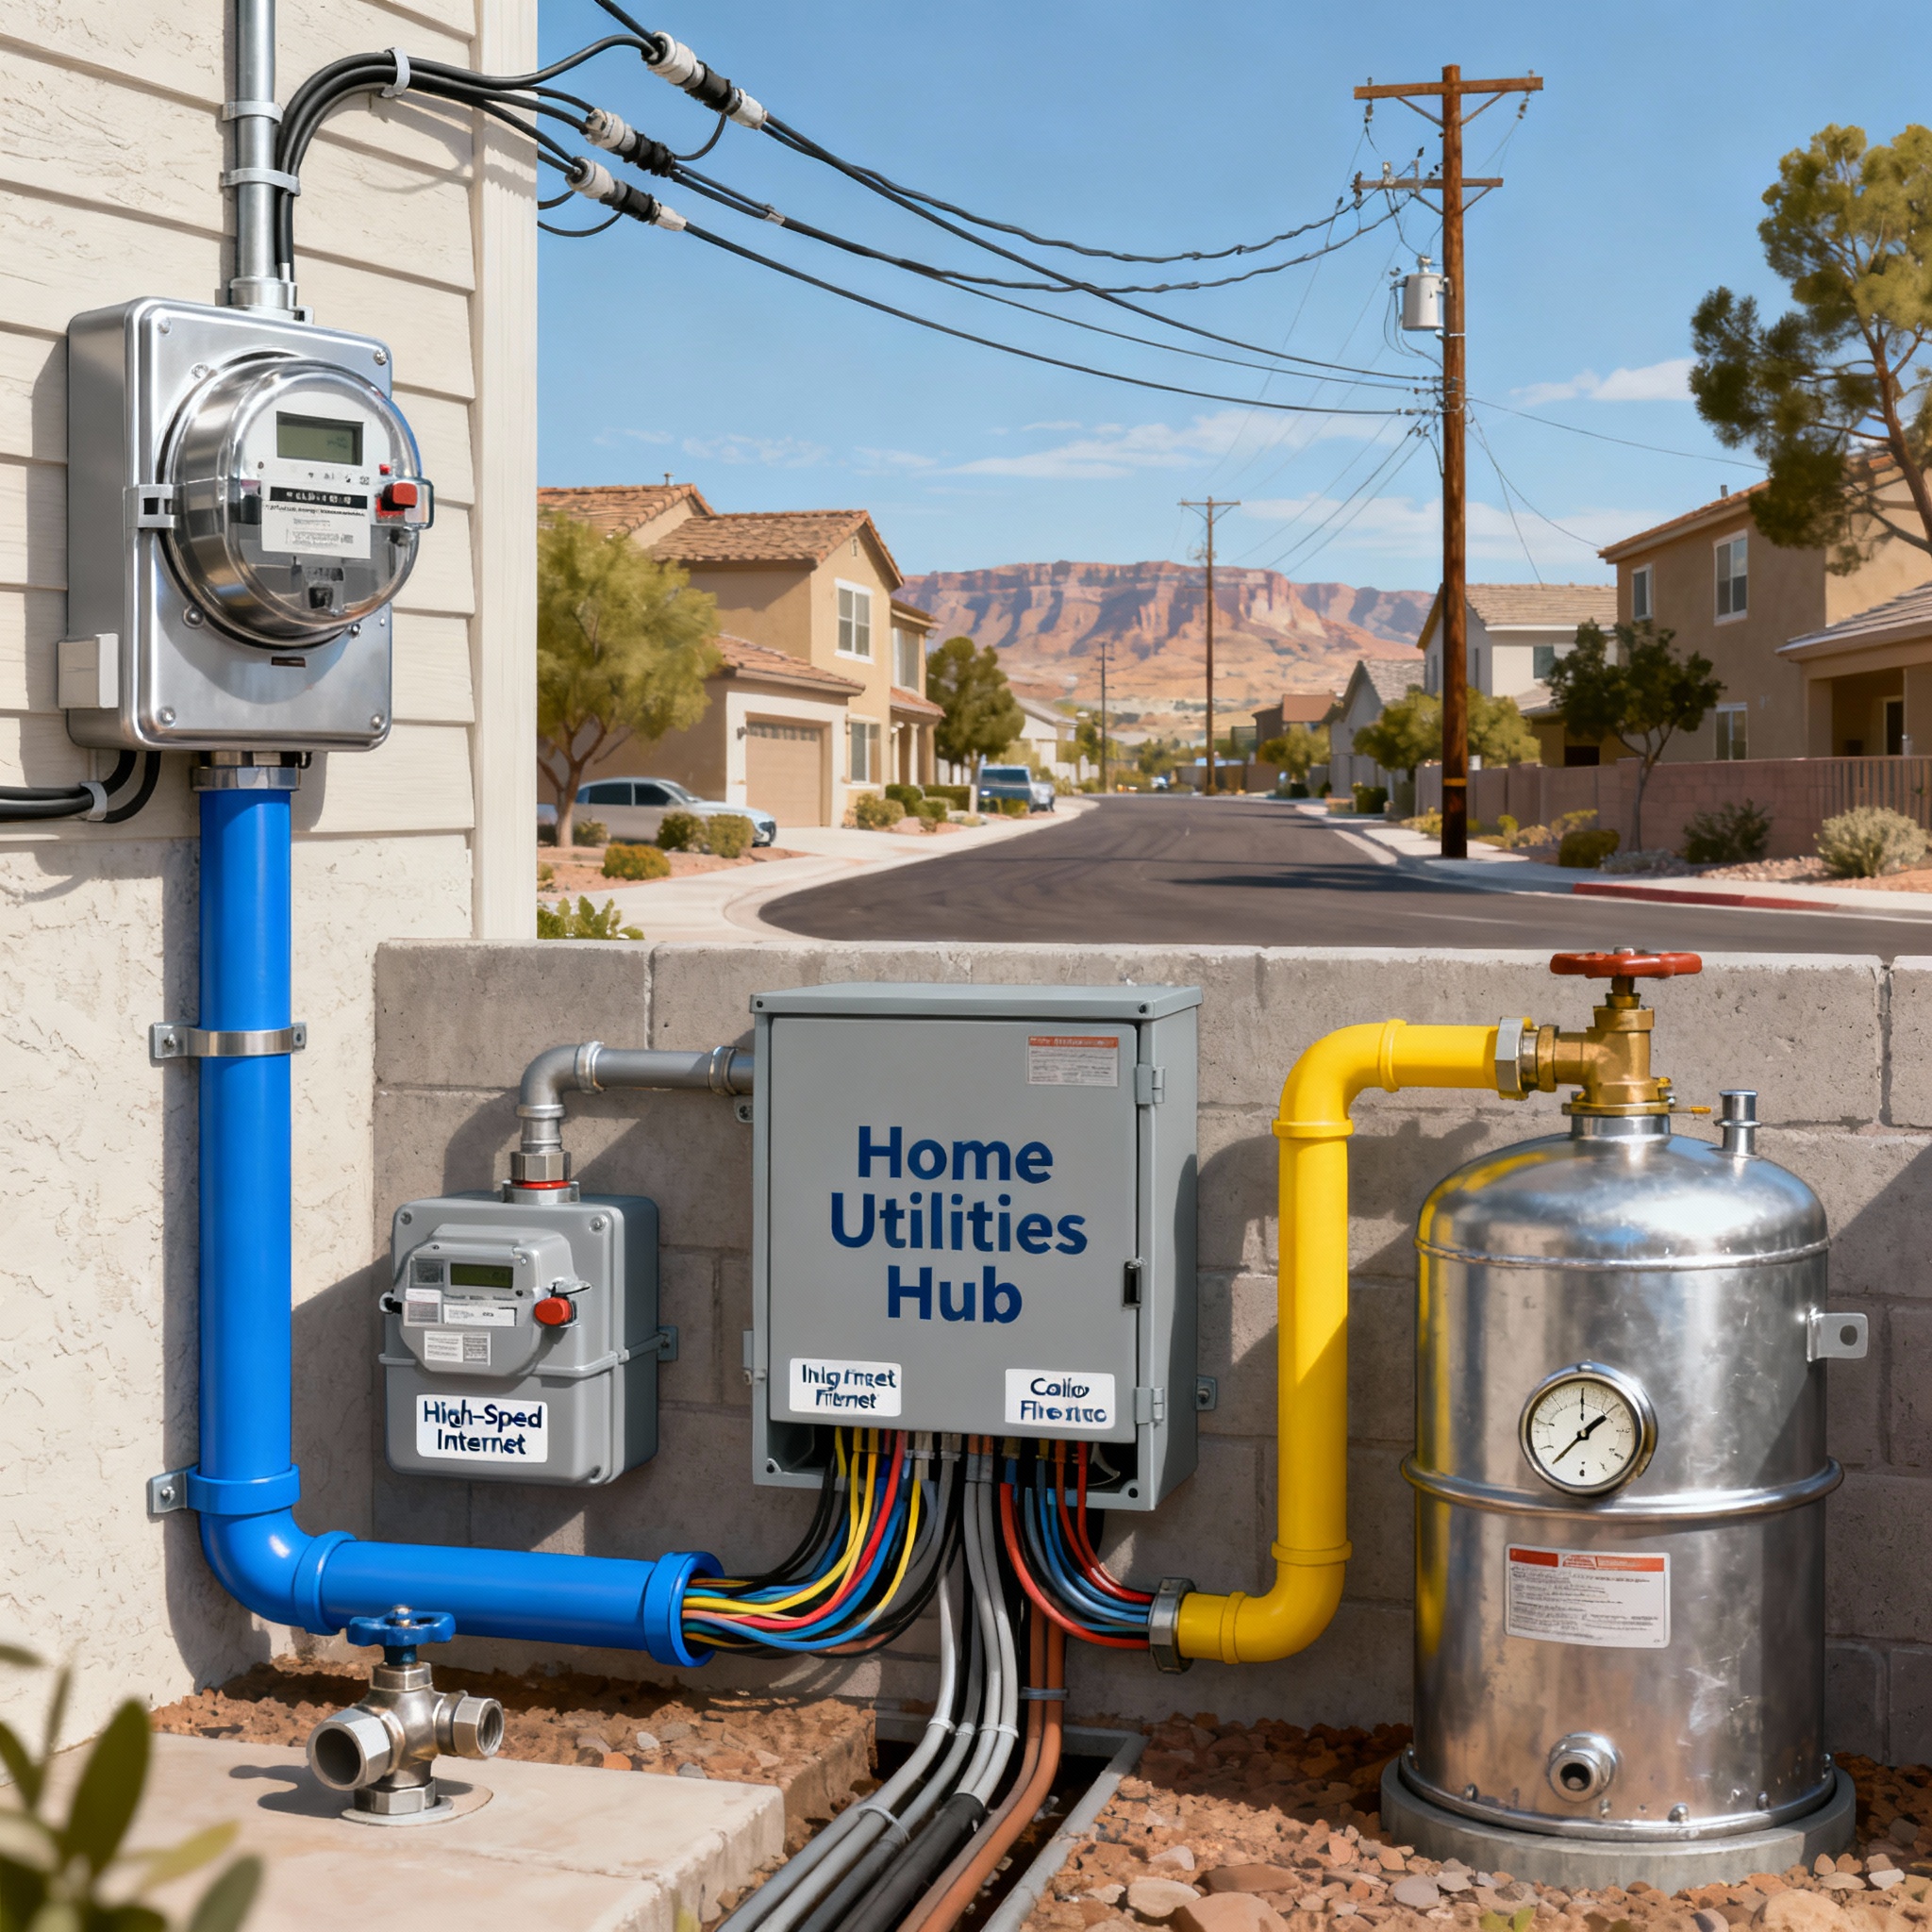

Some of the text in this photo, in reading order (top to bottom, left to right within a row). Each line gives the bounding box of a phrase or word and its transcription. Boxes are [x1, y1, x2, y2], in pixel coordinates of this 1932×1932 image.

[858, 1125, 1054, 1184] Home
[831, 1191, 1088, 1255] Utilities
[888, 1265, 1023, 1324] Hub
[424, 1399, 542, 1433] High-Sped
[438, 1428, 525, 1454] Internet
